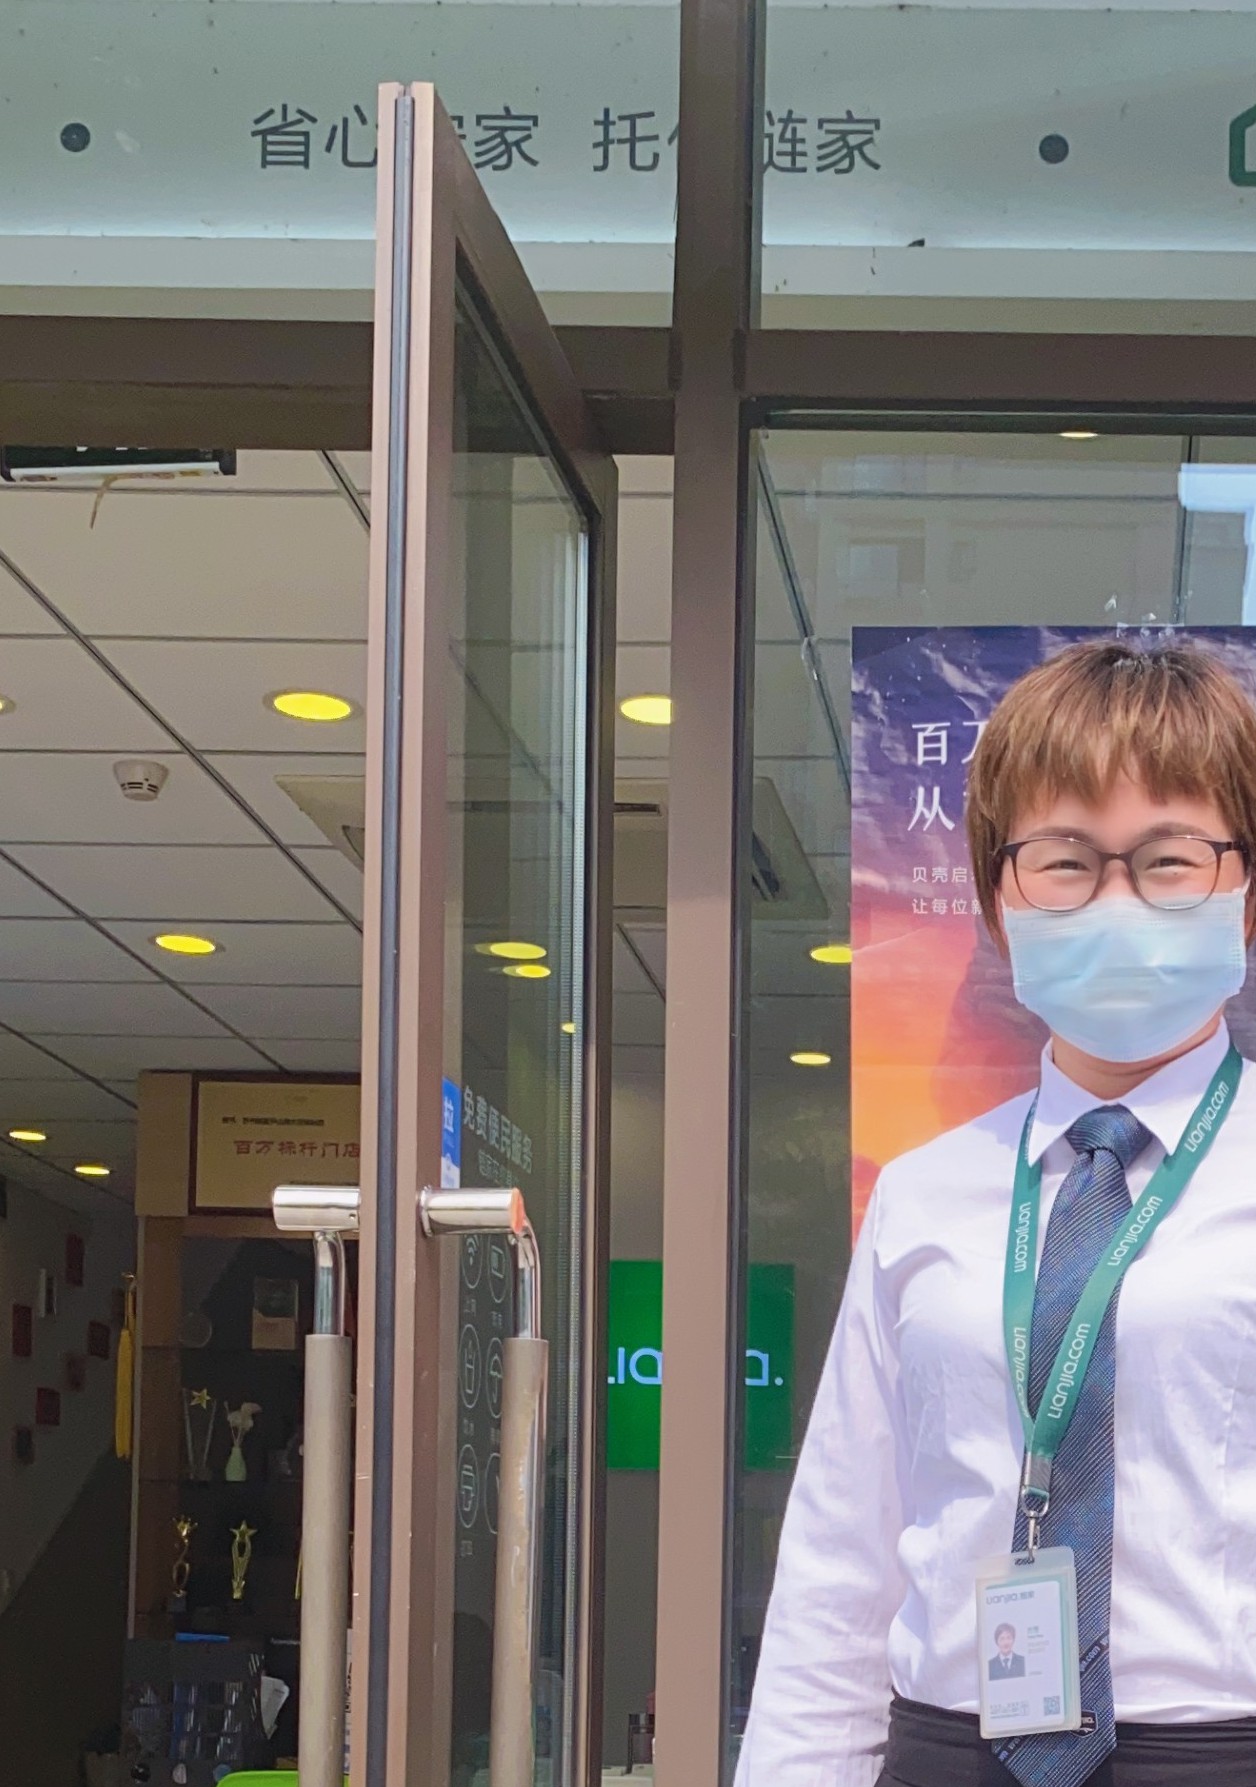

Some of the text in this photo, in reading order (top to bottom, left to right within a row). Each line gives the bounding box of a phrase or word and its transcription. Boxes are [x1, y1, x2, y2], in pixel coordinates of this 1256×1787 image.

[251, 103, 540, 172] 省心家
[912, 866, 974, 884] 贝壳启
[463, 1084, 533, 1175] 免费便民服务
